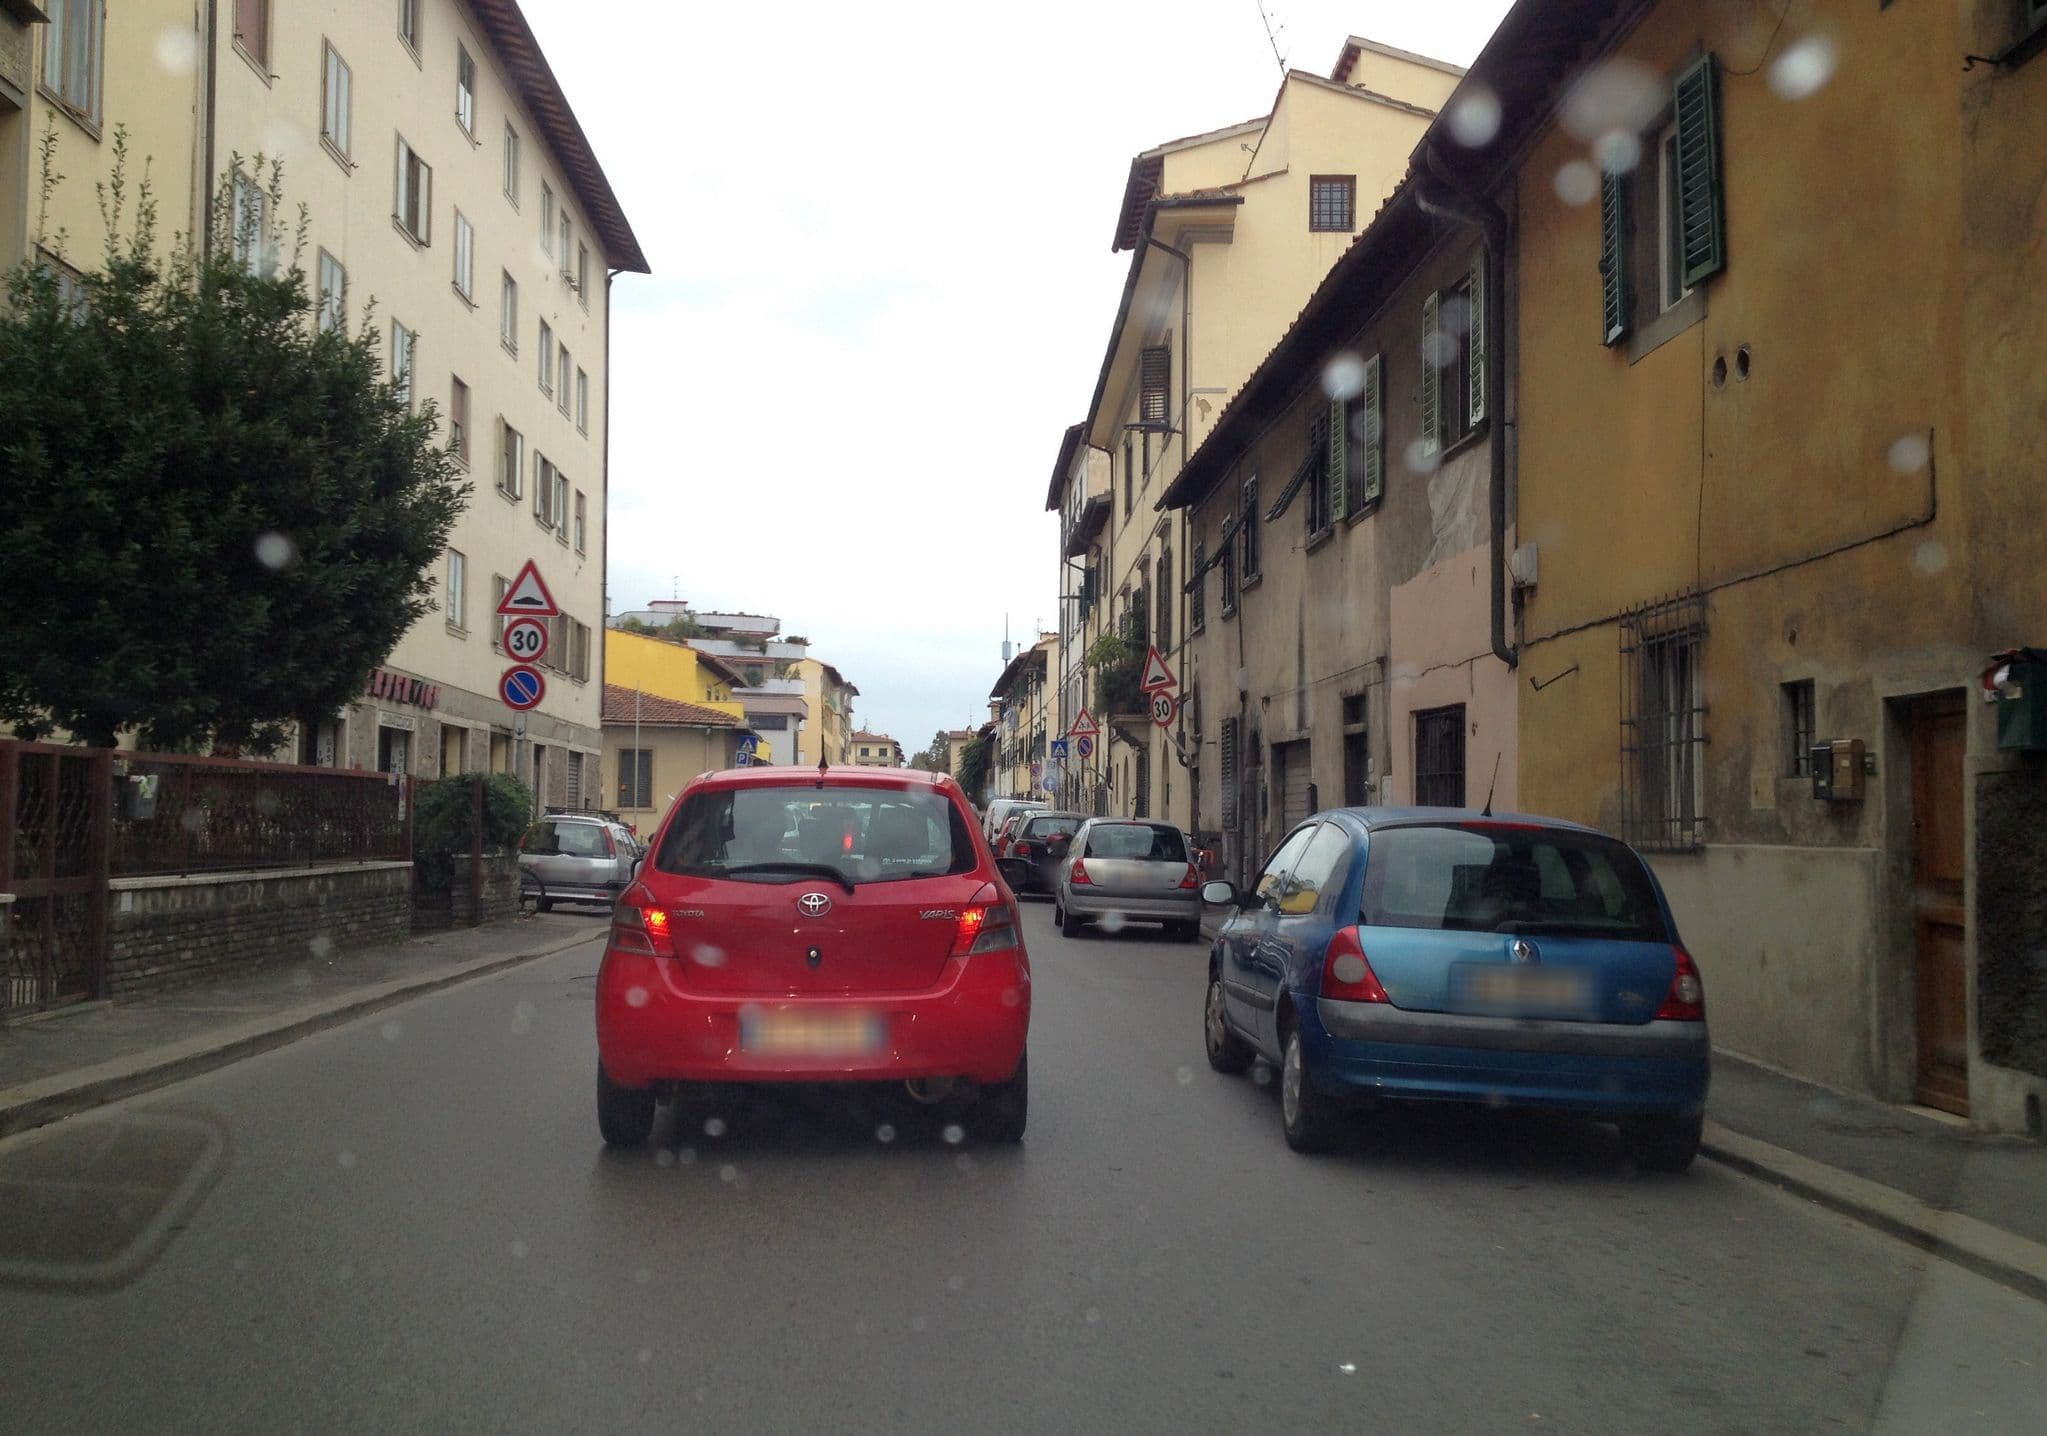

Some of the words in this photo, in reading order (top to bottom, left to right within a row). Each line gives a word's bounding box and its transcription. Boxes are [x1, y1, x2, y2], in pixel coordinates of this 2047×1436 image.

[513, 630, 539, 652] 30
[1154, 700, 1169, 718] 30
[920, 909, 955, 921] YARIS
